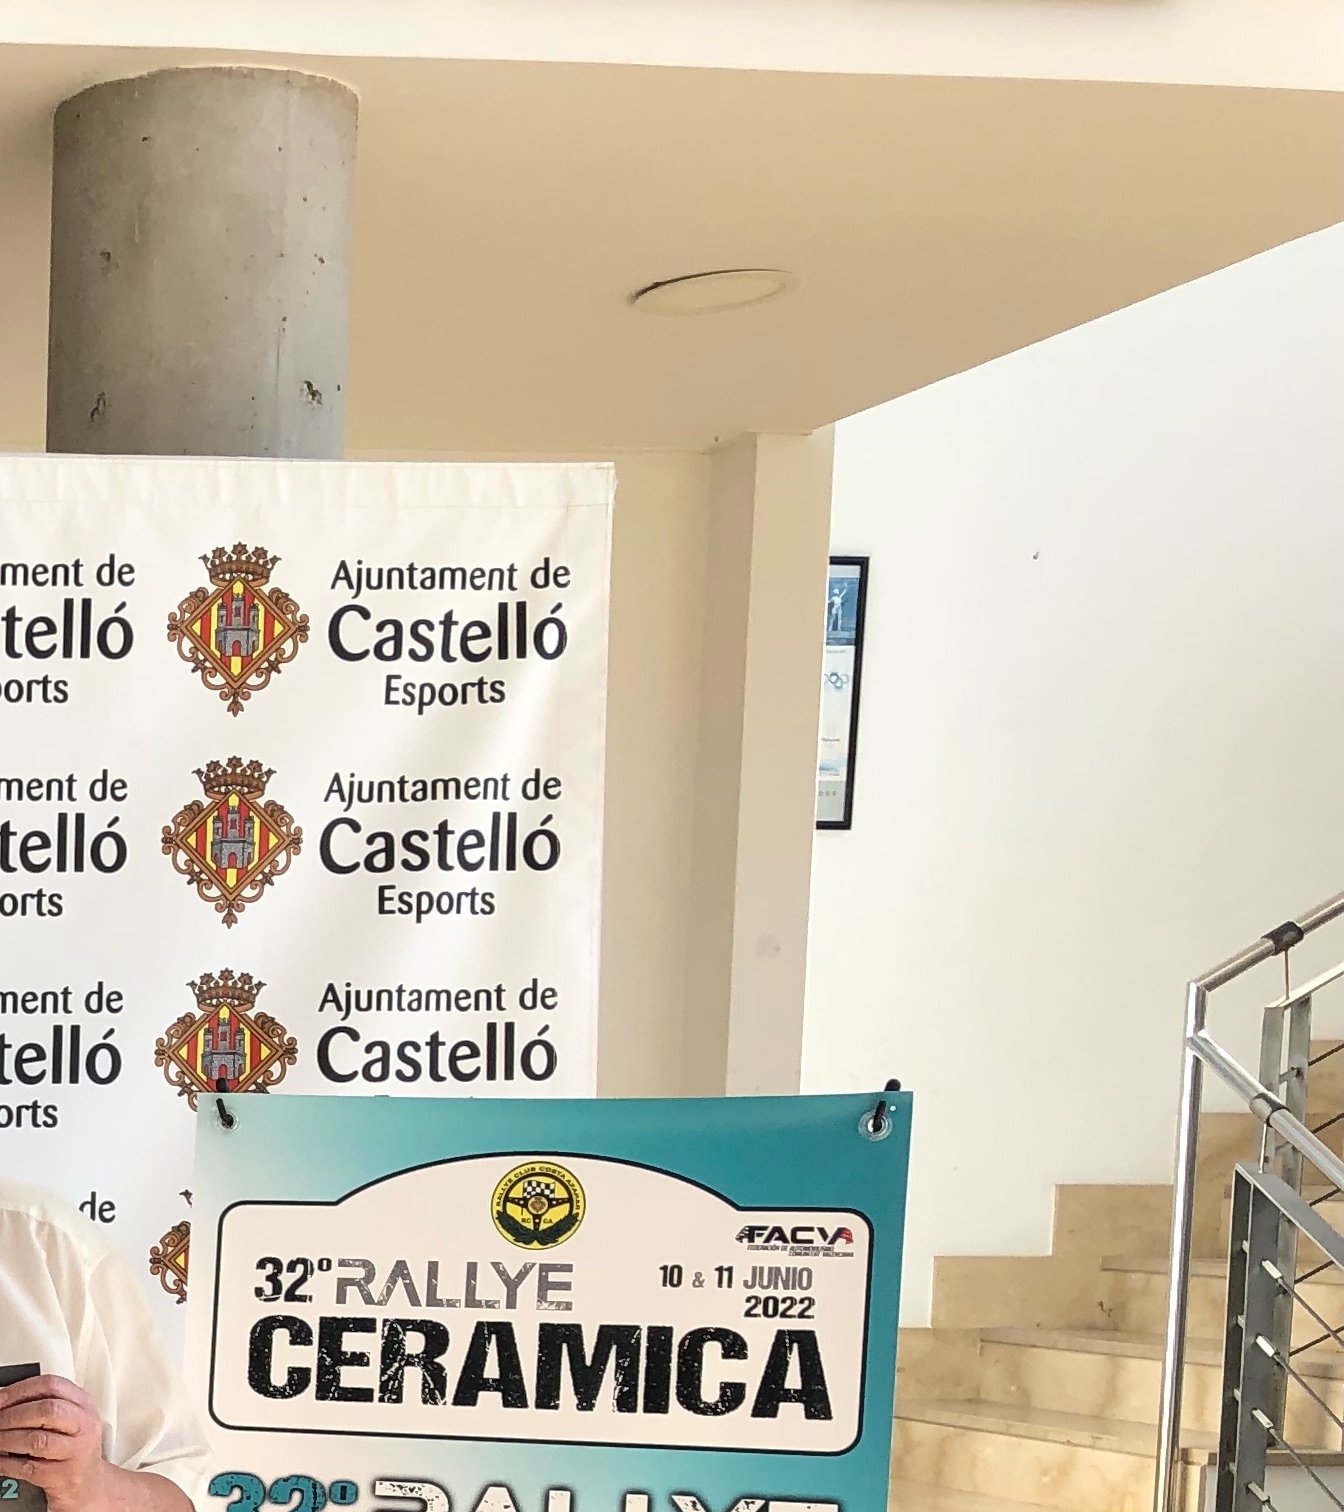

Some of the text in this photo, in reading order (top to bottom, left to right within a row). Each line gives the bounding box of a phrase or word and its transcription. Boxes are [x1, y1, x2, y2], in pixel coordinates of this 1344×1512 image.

[96, 553, 135, 587] de
[330, 557, 571, 600] Ajuntament de
[328, 600, 568, 663] Castelló
[384, 674, 506, 716] Esports
[323, 768, 562, 812] Ajuntament de
[319, 811, 561, 875] Castelló
[378, 884, 495, 924] Esports
[336, 1259, 573, 1311] RALLYE
[659, 1264, 813, 1291] 10 & 11 JUNIO
[744, 1296, 815, 1320] 2022
[247, 1314, 832, 1421] CERAMICA
